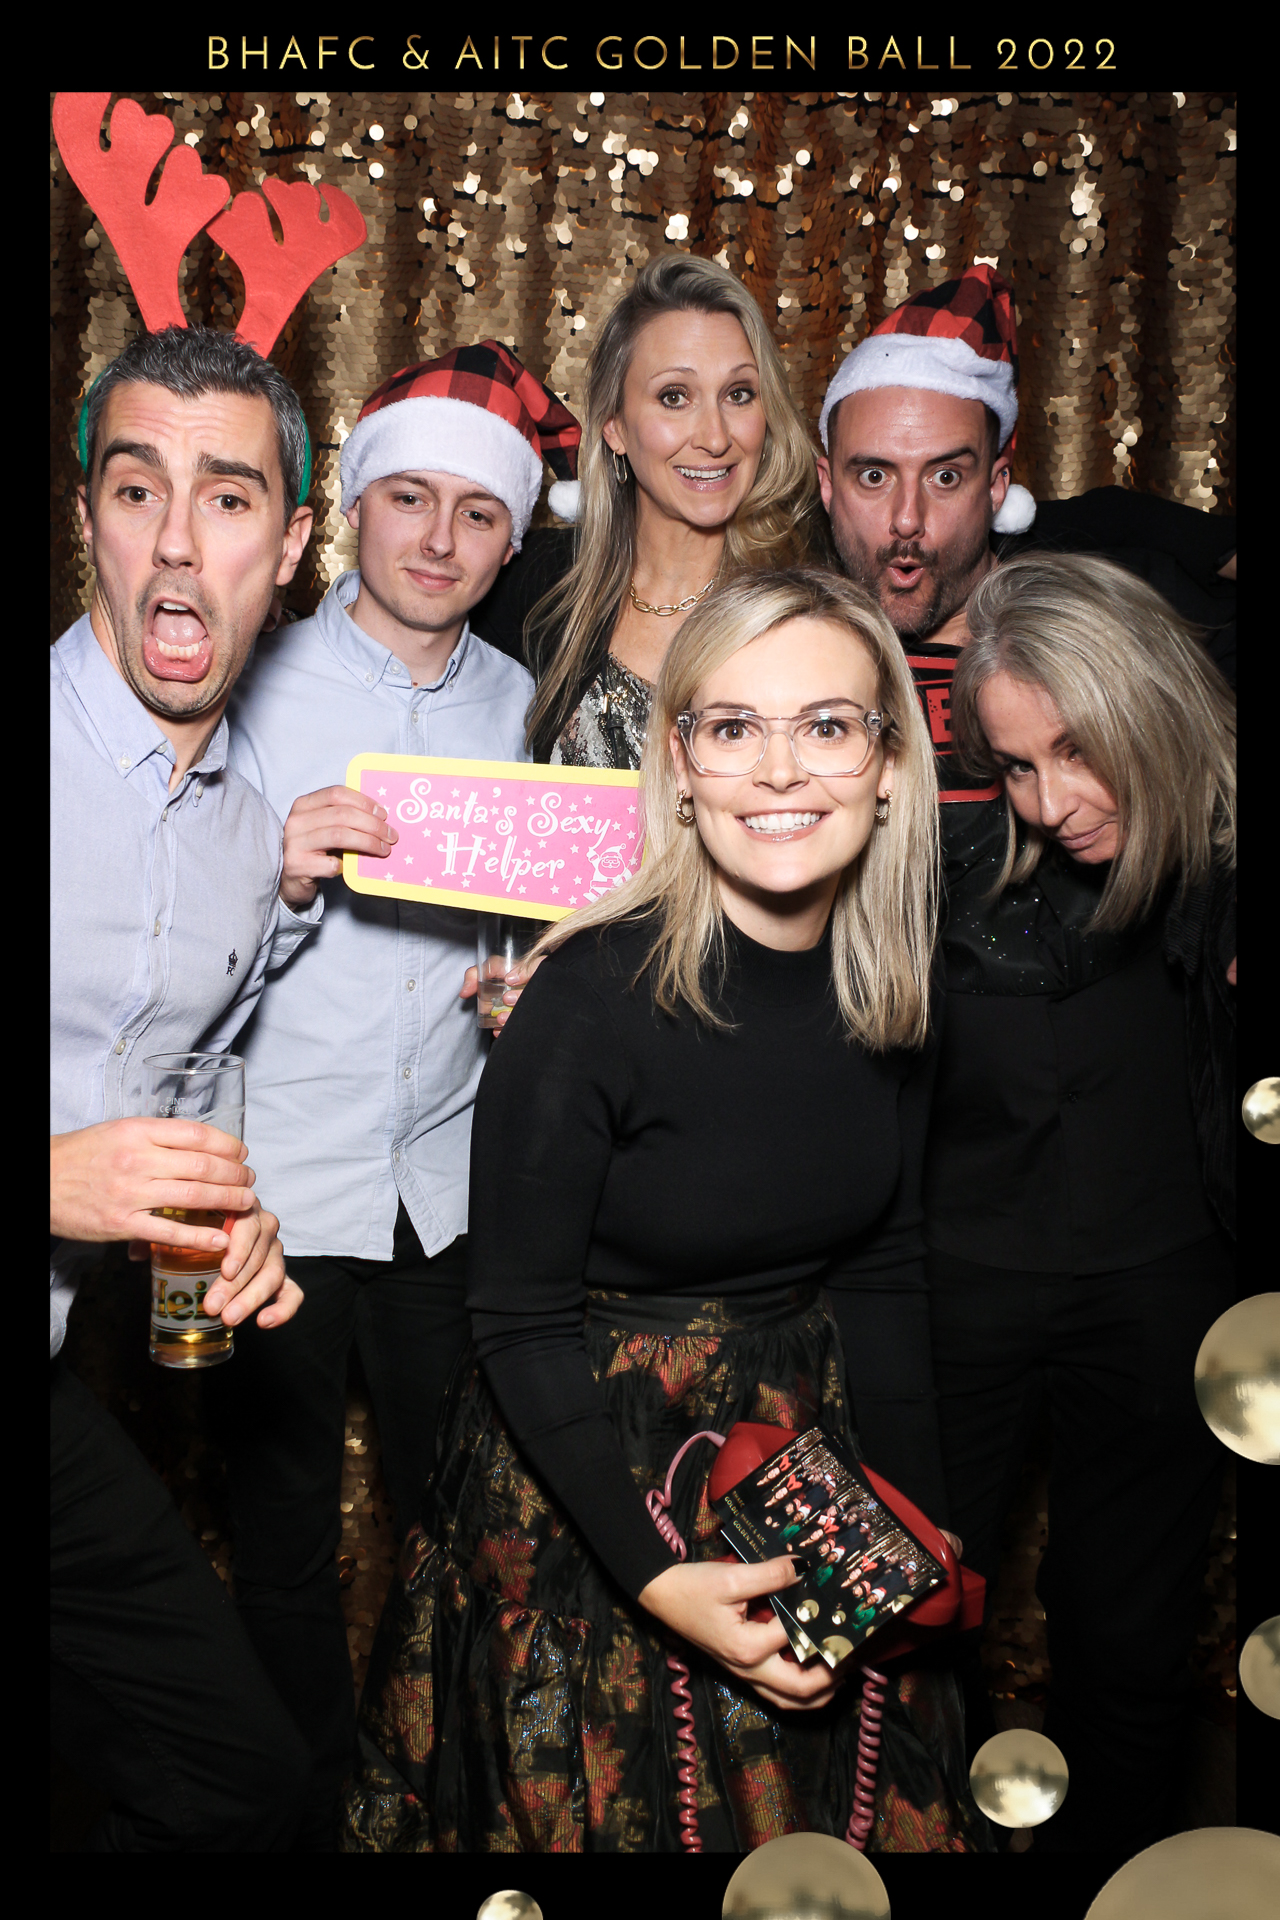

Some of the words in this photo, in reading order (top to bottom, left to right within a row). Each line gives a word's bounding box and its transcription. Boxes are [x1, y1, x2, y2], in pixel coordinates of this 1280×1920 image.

[395, 777, 517, 836] Santa's
[526, 791, 612, 850] Sexy
[436, 831, 565, 893] Helper
[166, 1096, 186, 1106] PINT
[732, 1520, 750, 1541] GOLDEN
